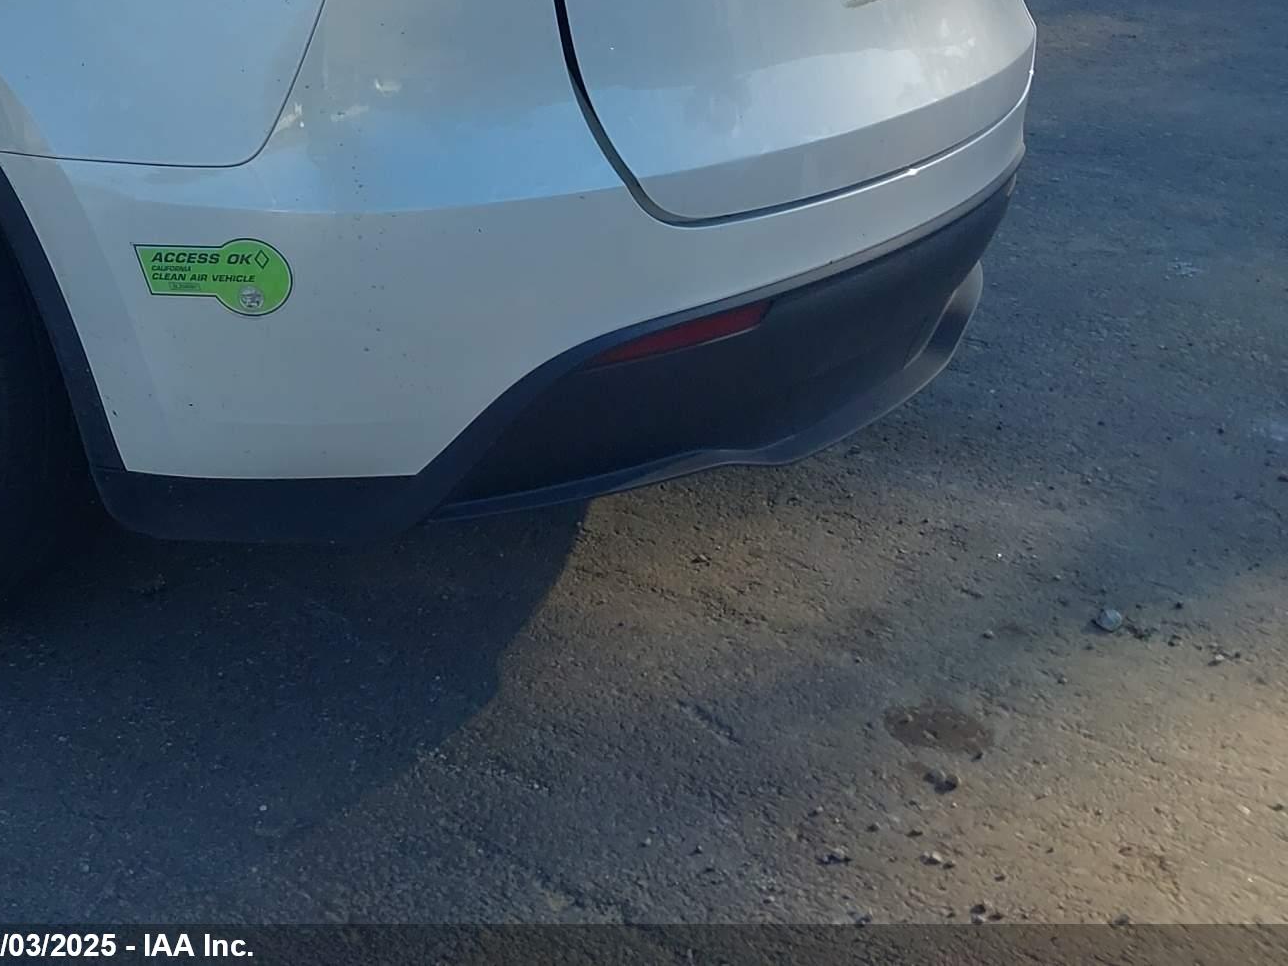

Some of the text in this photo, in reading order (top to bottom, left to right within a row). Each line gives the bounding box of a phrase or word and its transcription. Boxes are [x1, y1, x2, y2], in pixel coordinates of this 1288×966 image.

[151, 252, 253, 265] ACCESS OK
[152, 272, 256, 283] CLEAN AIR VEHICLE
